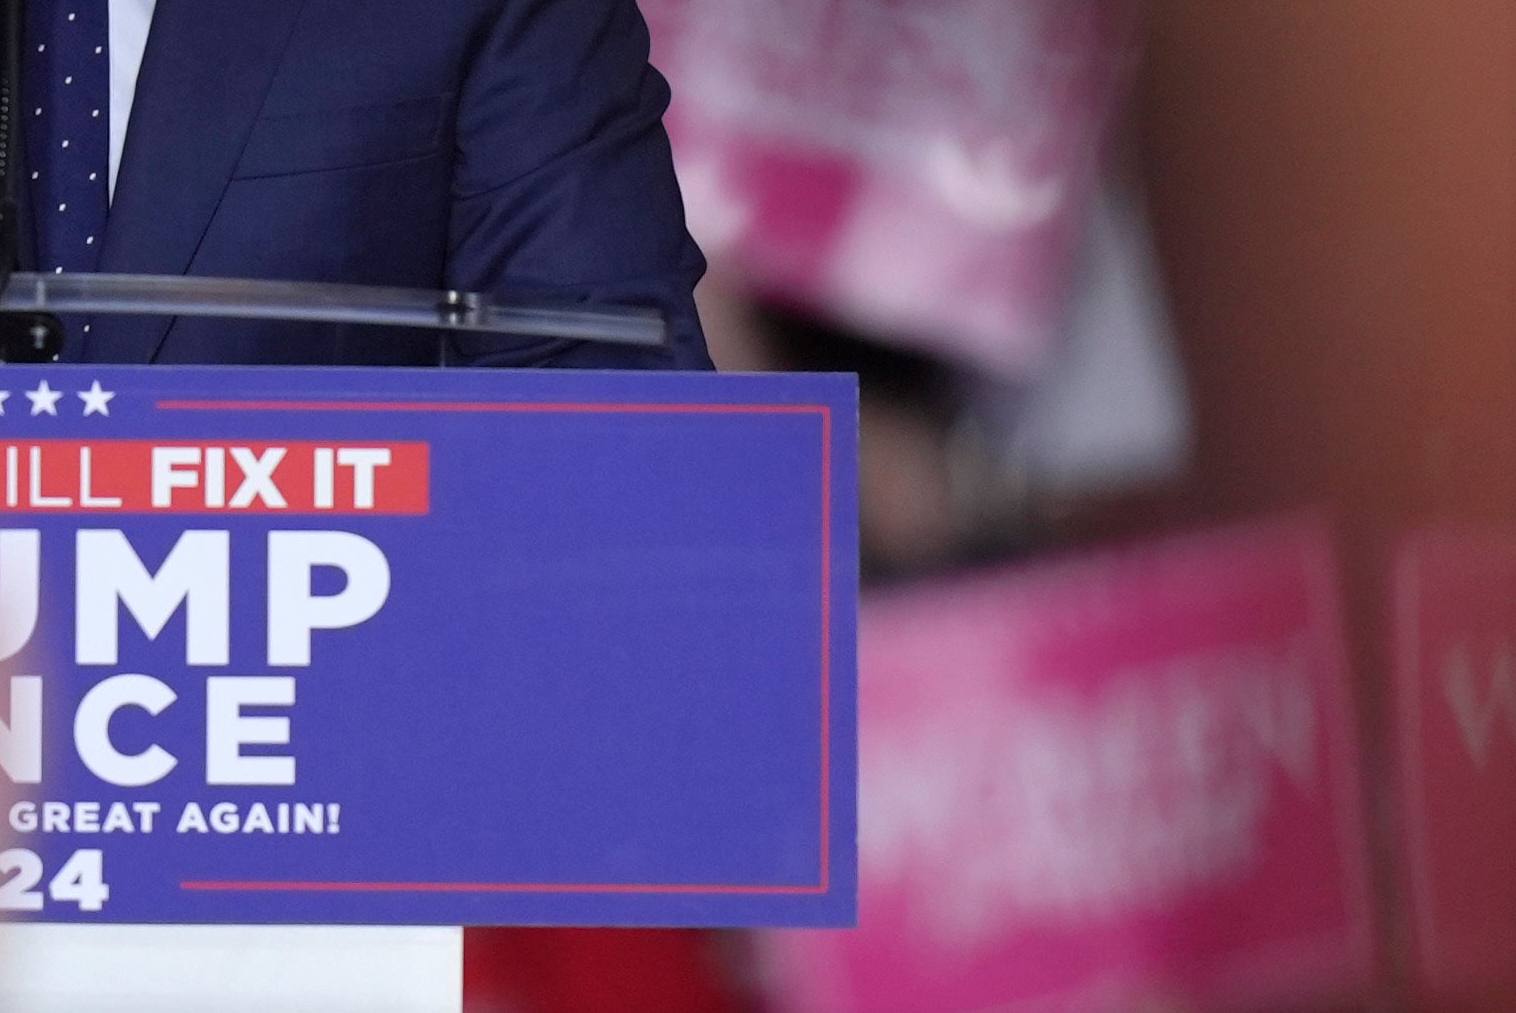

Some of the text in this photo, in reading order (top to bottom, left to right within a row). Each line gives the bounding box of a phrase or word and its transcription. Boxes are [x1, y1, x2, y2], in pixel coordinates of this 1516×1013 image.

[152, 447, 287, 509] FIX
[314, 448, 391, 509] IT
[8, 801, 161, 833] GREAT
[176, 802, 341, 834] AGAIN!
